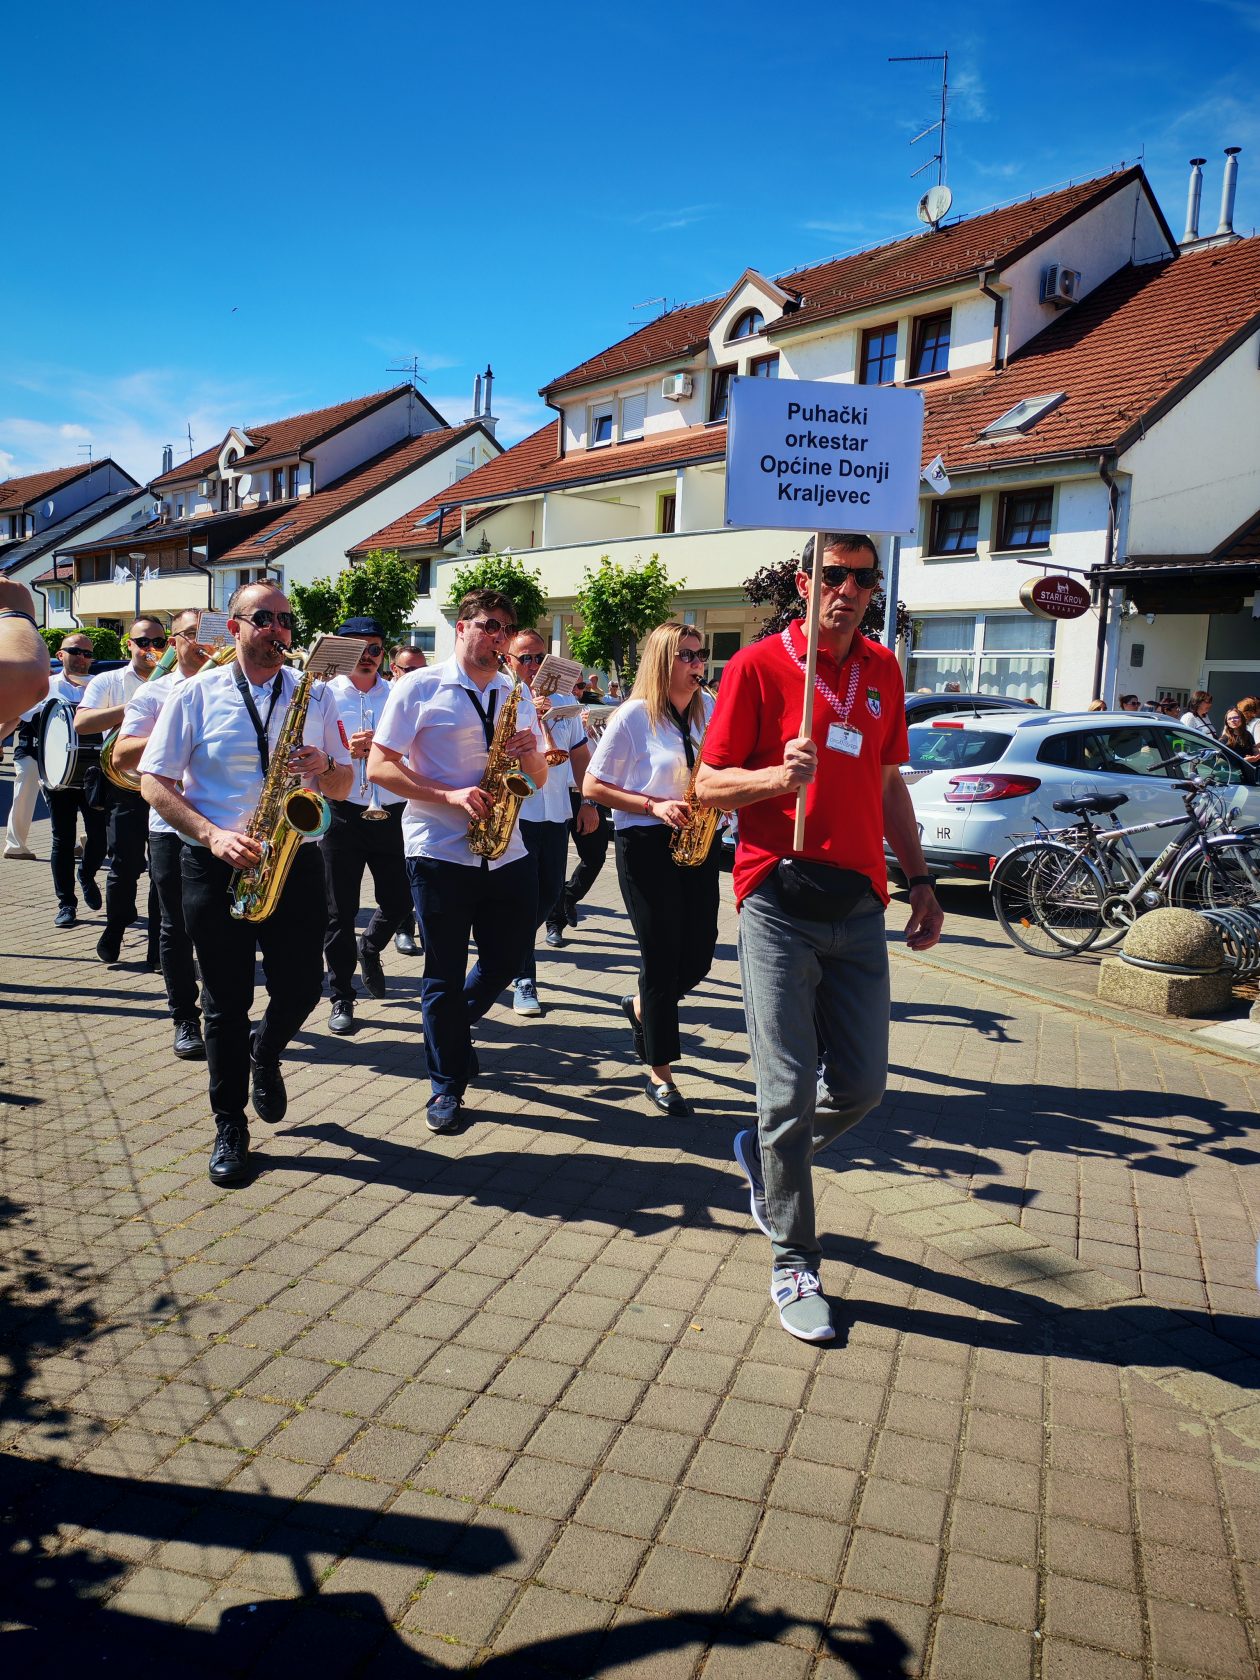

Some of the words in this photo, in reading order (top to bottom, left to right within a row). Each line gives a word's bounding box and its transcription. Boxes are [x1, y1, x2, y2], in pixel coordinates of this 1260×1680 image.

[787, 402, 868, 426] Puhački
[785, 430, 869, 452] orkestar
[760, 454, 832, 478] Općine
[839, 459, 889, 484] Donji
[778, 482, 871, 506] Kraljevec
[1040, 591, 1062, 601] STARI
[1063, 595, 1083, 604] KROV
[936, 827, 951, 840] HR
